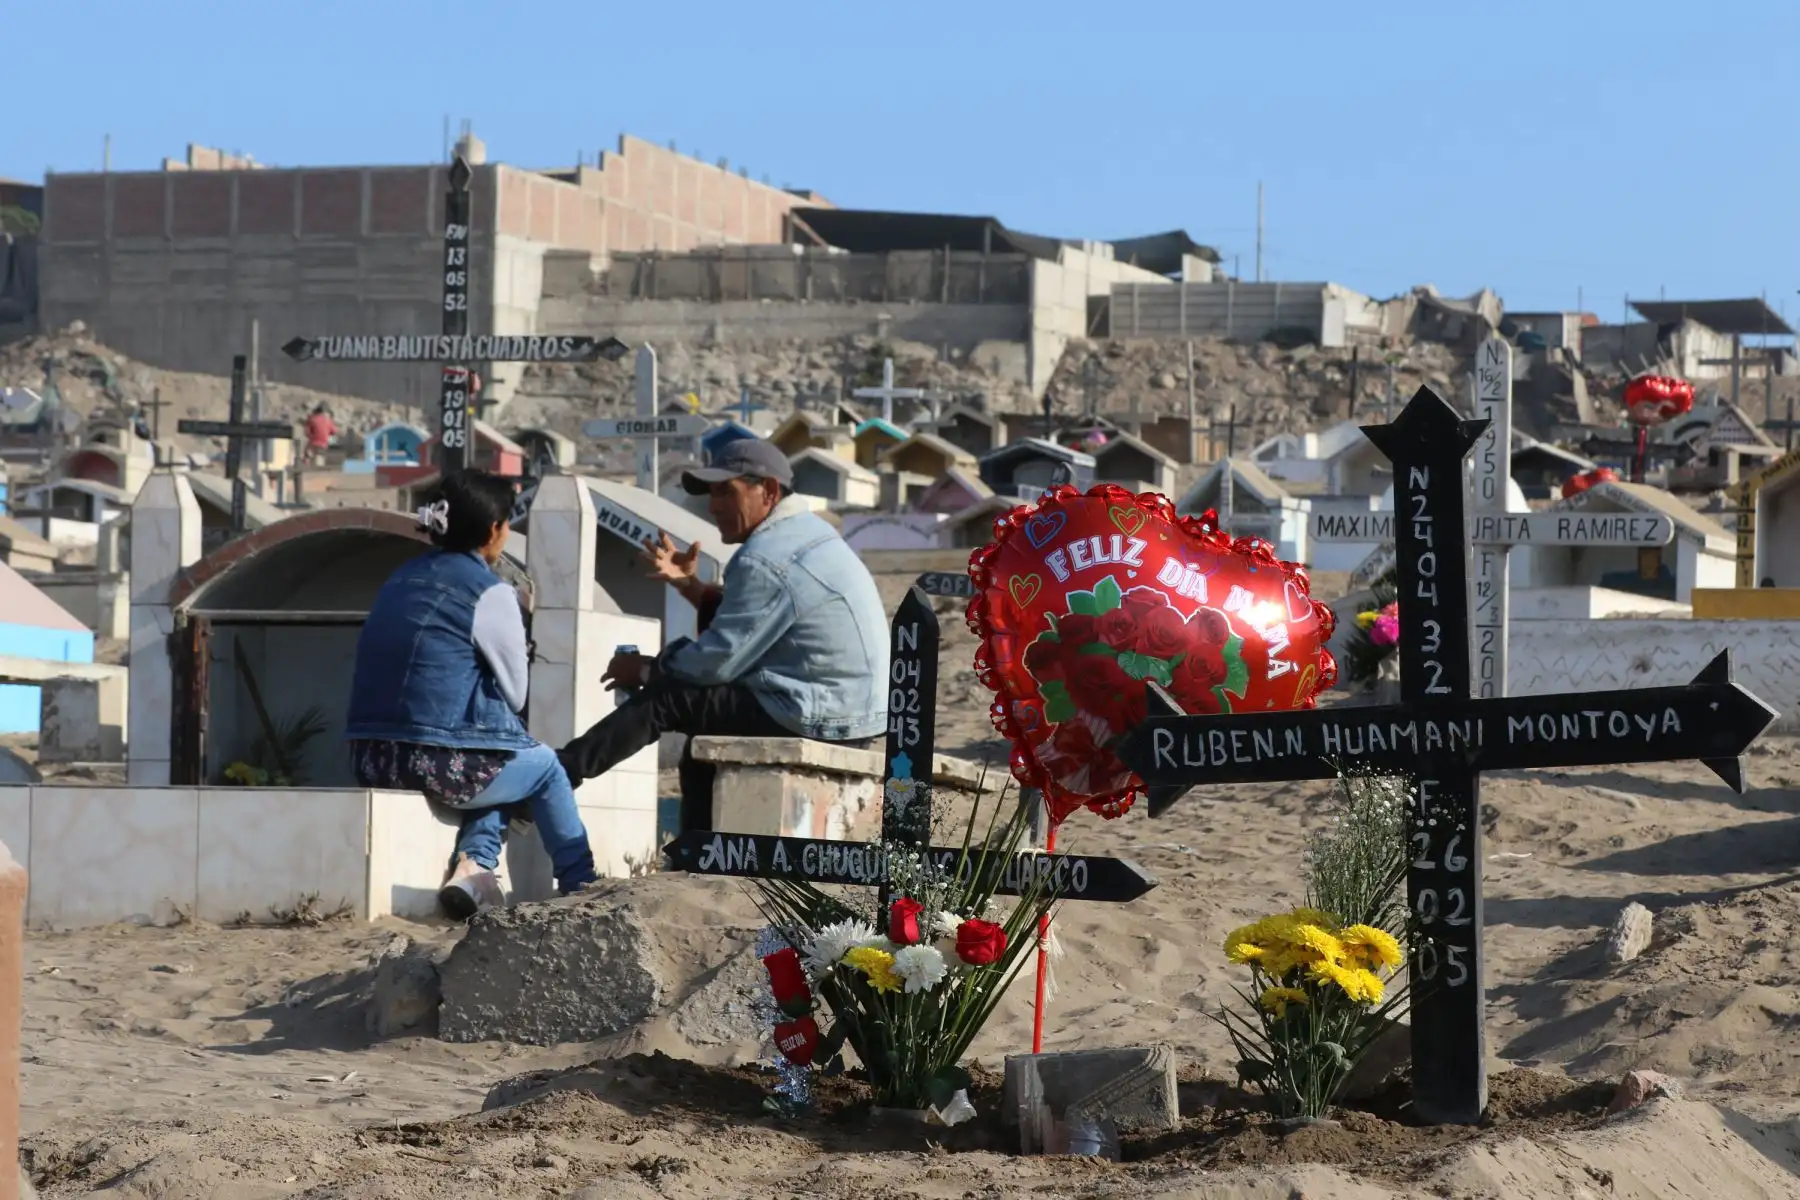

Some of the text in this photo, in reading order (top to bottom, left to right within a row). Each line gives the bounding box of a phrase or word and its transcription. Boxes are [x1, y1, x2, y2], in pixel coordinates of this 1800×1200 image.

[447, 247, 466, 266] 13
[446, 271, 466, 286] 05
[444, 293, 467, 311] 52
[314, 335, 573, 361] JUANA BAUTISTA CUADROS
[444, 390, 464, 409] 19
[443, 409, 464, 428] 01
[442, 429, 466, 448] 05
[1557, 517, 1659, 541] RAMIREZ
[1045, 534, 1148, 583] FELIZ
[1222, 584, 1299, 680] MMÁ
[898, 622, 919, 651] N
[891, 658, 921, 687] 04
[889, 688, 921, 714] 02
[889, 716, 921, 748] 43
[1321, 718, 1483, 755] HUAMANI
[1507, 706, 1682, 744] MONTOYA
[698, 833, 759, 873] ANA
[1411, 831, 1468, 873] 26
[1416, 887, 1472, 926] 02
[1417, 943, 1469, 987] 05
